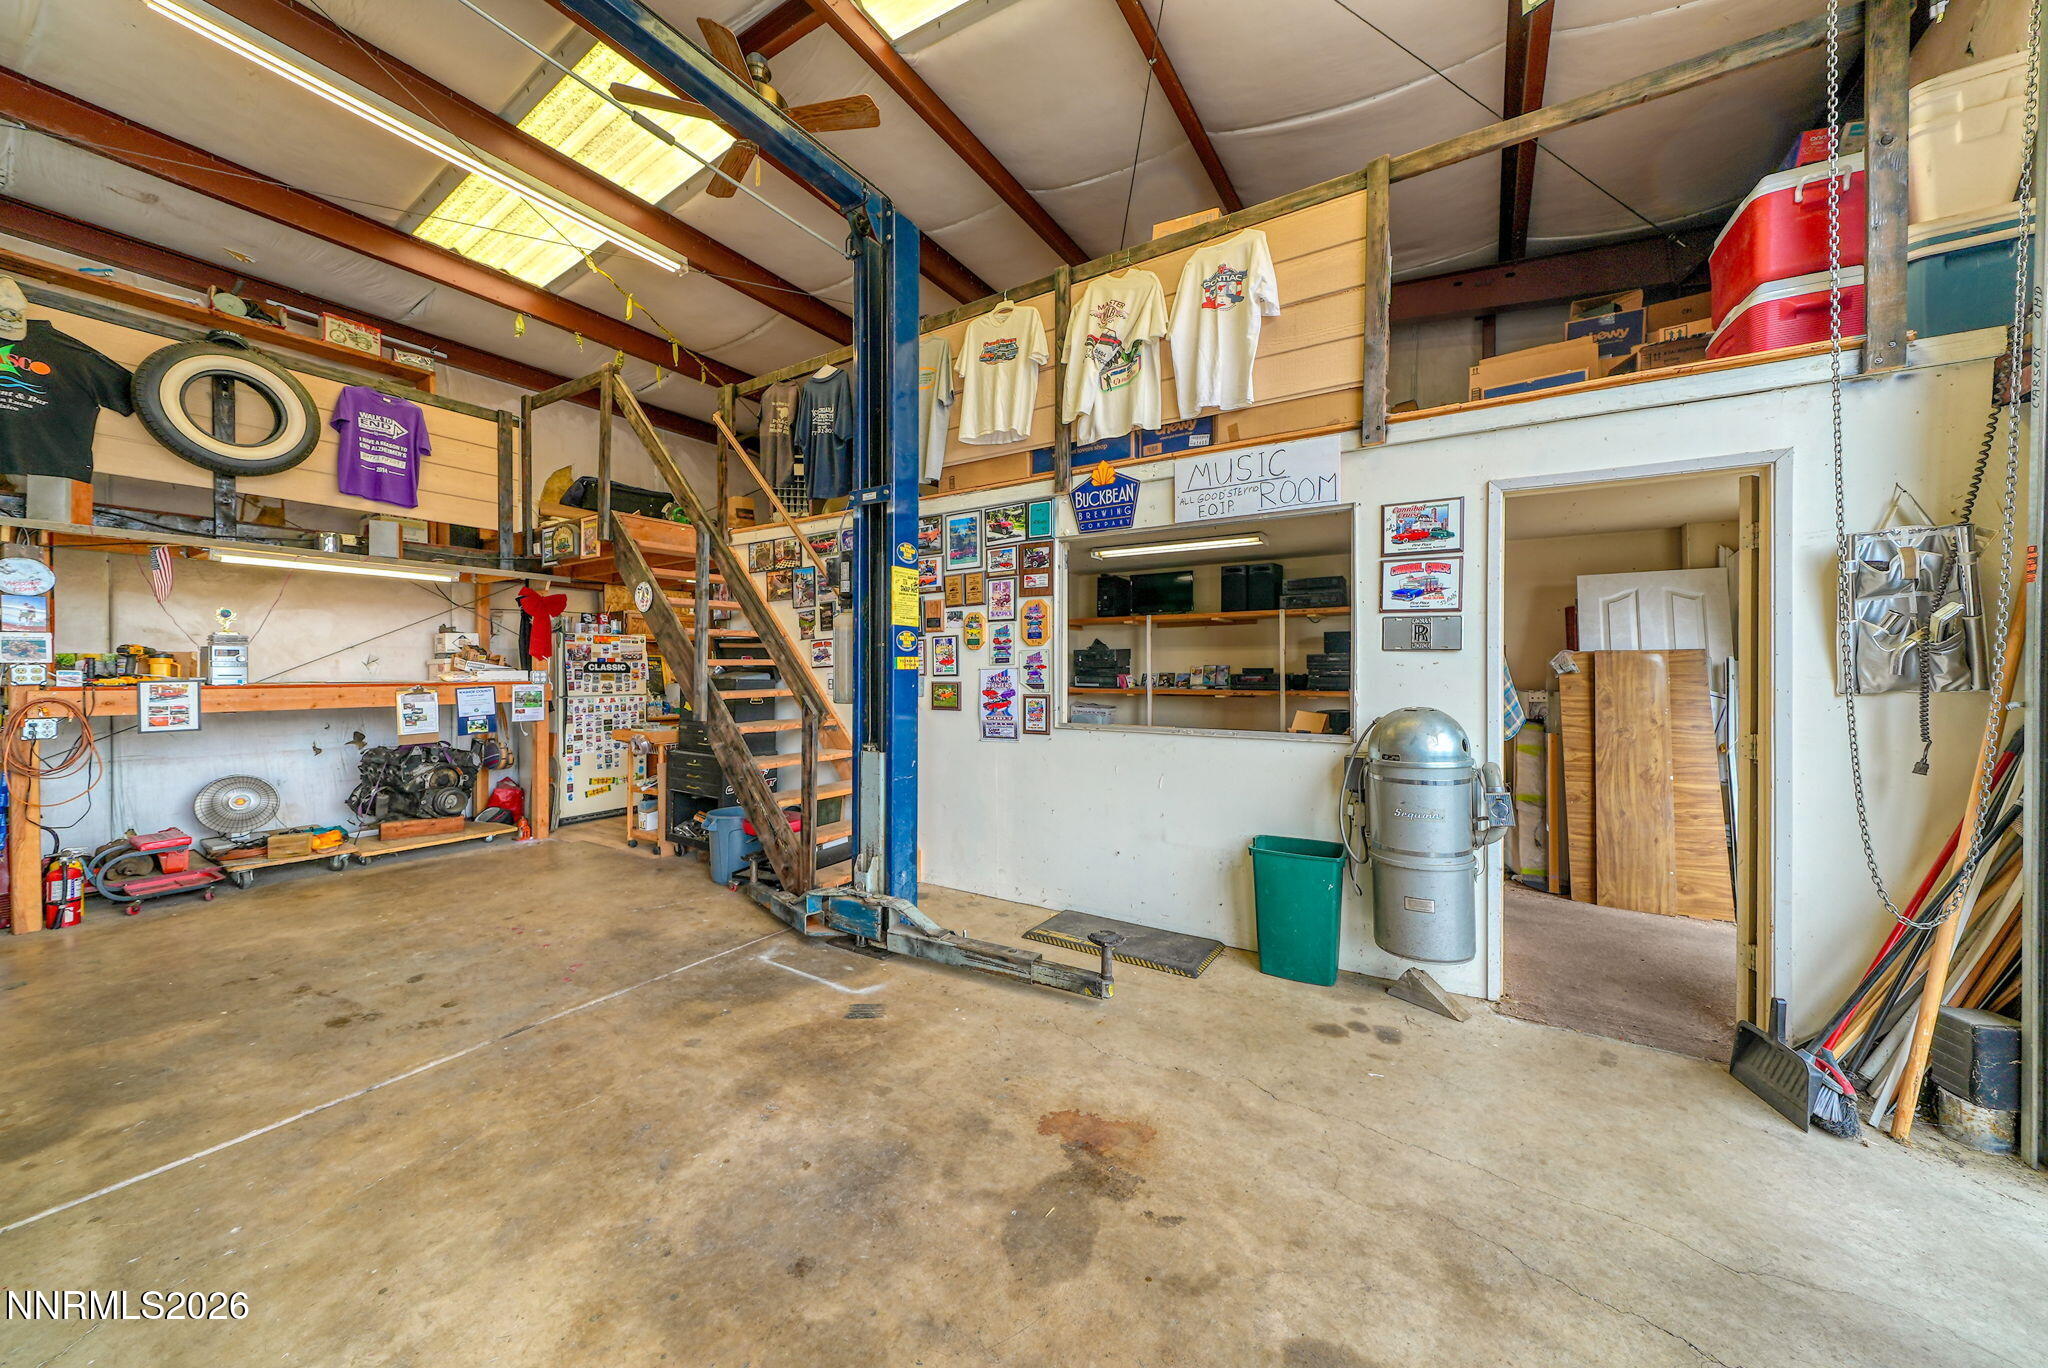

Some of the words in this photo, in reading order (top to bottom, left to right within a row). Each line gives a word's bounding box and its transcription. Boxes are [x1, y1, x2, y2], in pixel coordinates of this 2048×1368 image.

[1592, 327, 1630, 342] hewy
[359, 411, 382, 422] WALK
[383, 416, 392, 425] TO
[360, 418, 391, 430] END
[1187, 449, 1286, 489] MUSIC
[1075, 483, 1134, 509] BUCKBEAN
[1259, 473, 1337, 508] ROOM
[1078, 505, 1132, 521] BREWING
[1080, 518, 1131, 530] COMPANY
[588, 663, 627, 672] CLASSIC
